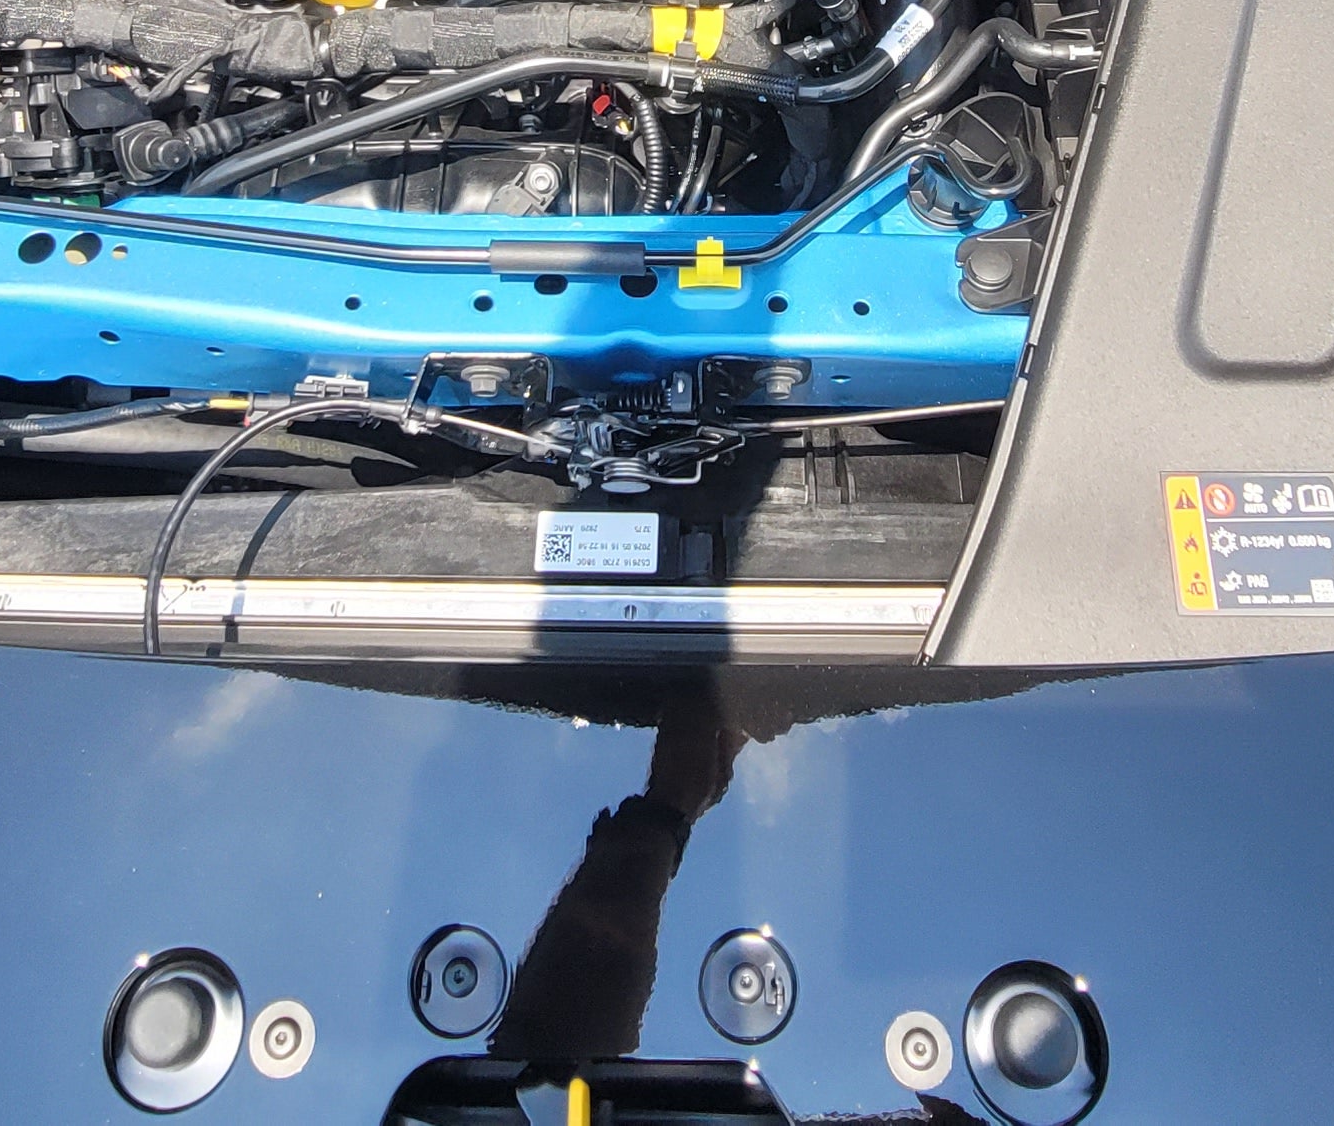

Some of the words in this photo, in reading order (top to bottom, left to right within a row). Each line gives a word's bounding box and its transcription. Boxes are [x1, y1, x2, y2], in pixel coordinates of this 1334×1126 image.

[1244, 504, 1268, 514] AUTO
[1239, 535, 1285, 550] R-1234yf
[1316, 534, 1332, 549] kg
[1246, 574, 1270, 588] PAG
